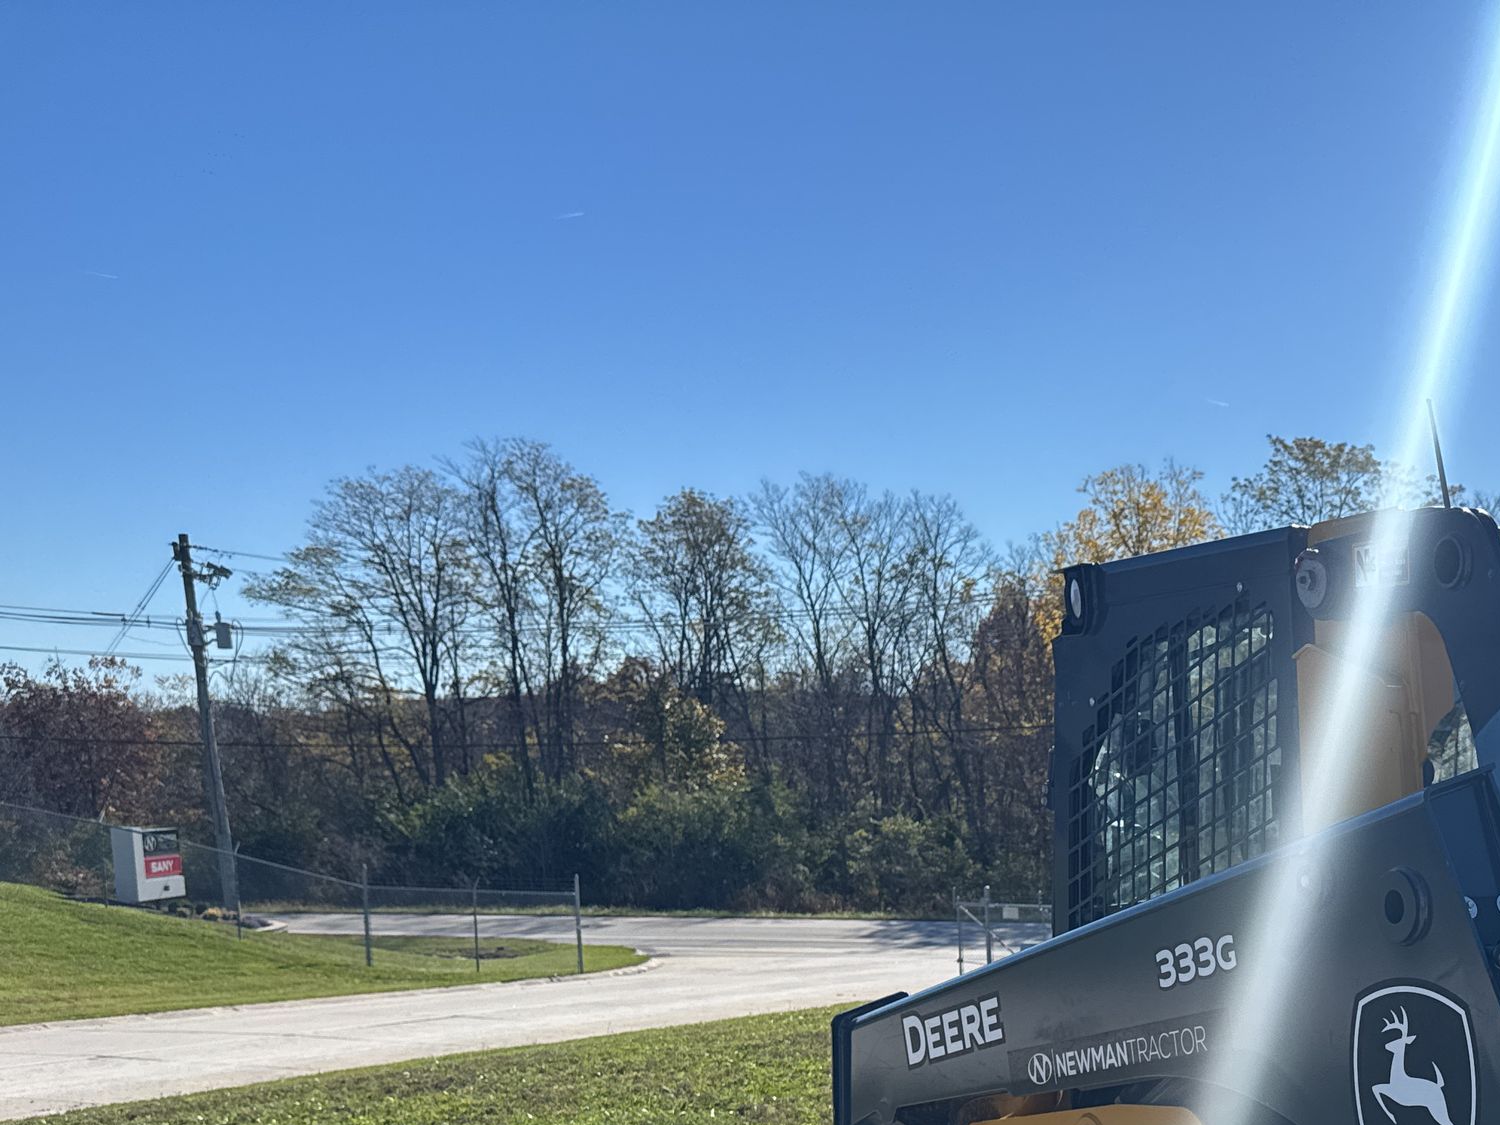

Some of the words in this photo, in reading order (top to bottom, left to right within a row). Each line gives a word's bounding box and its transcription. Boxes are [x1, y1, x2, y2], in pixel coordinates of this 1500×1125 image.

[151, 860, 174, 873] SANY
[1155, 934, 1237, 988] 333G
[902, 997, 1003, 1065] DEERE
